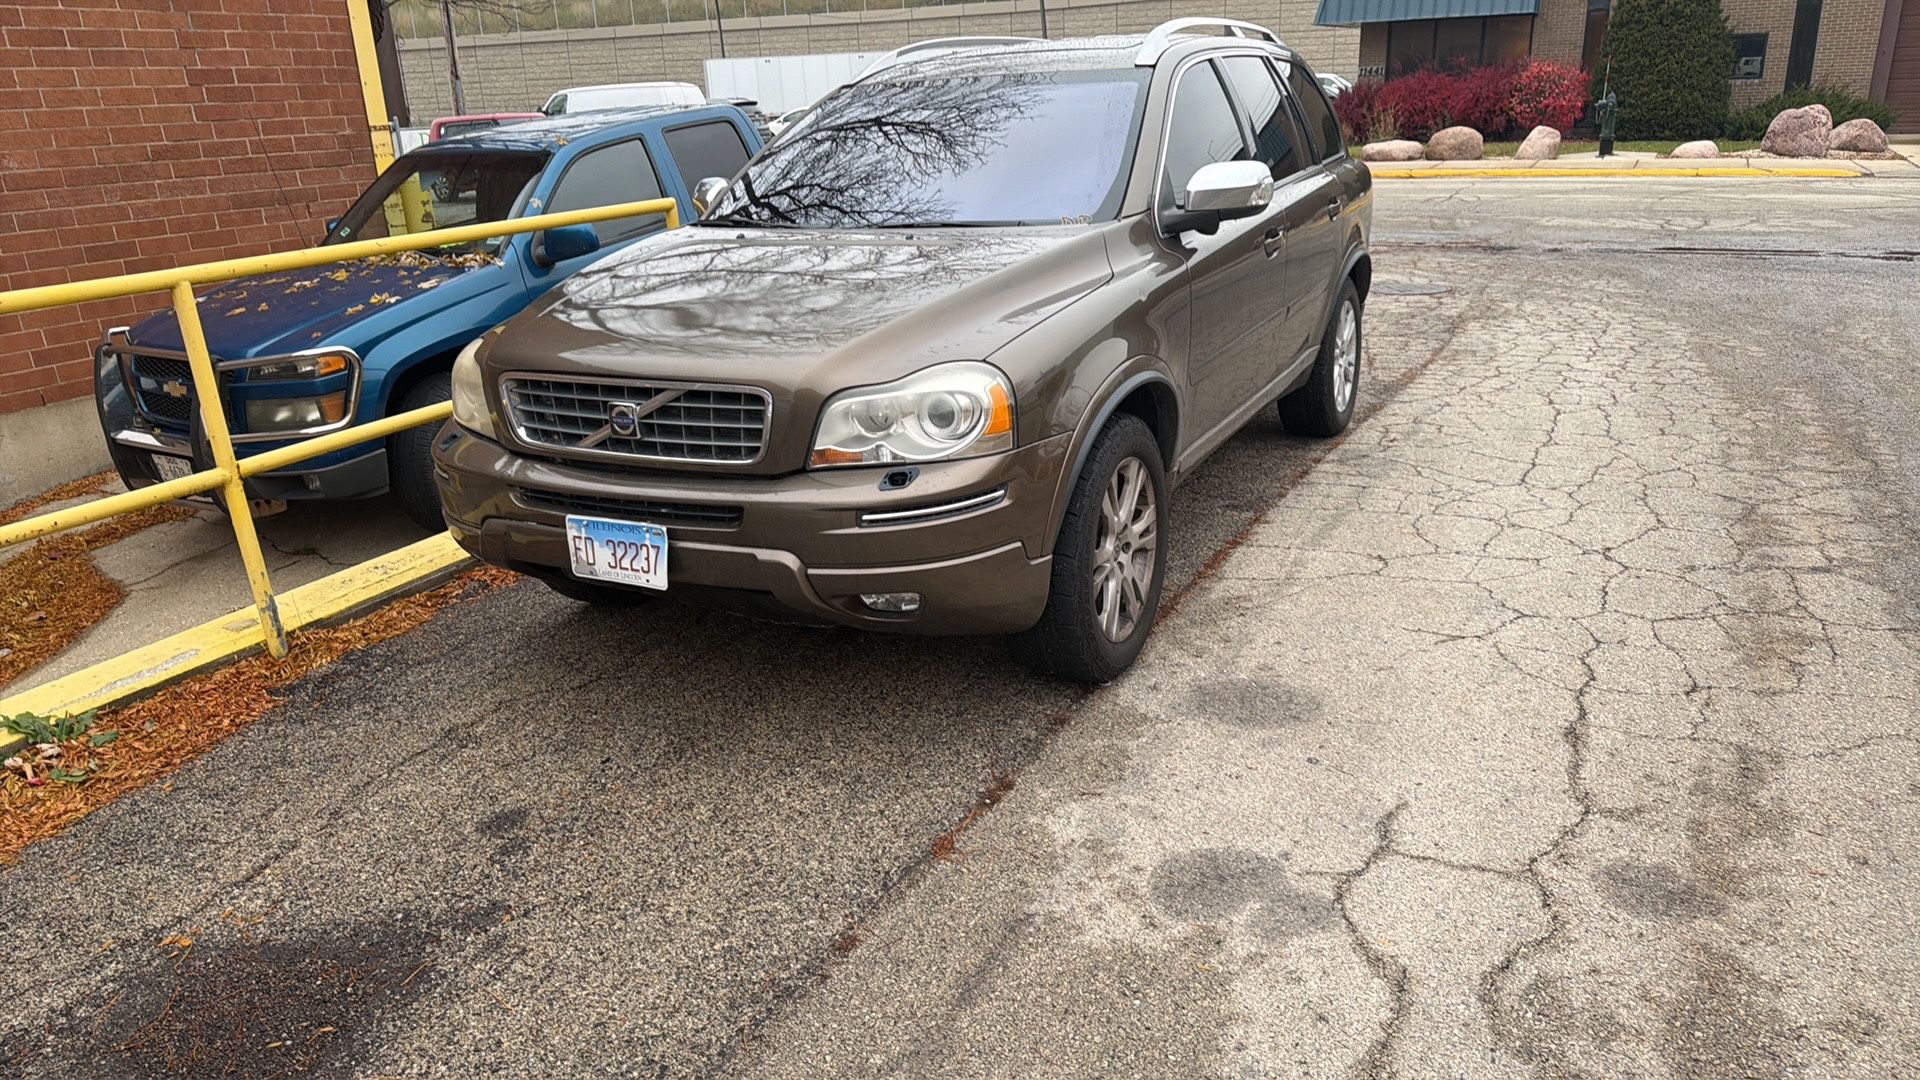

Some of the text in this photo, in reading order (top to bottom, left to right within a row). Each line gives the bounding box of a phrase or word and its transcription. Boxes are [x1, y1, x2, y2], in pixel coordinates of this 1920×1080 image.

[1360, 67, 1384, 76] 11441
[592, 522, 642, 535] ILLINOIS
[573, 535, 661, 576] FD 32237
